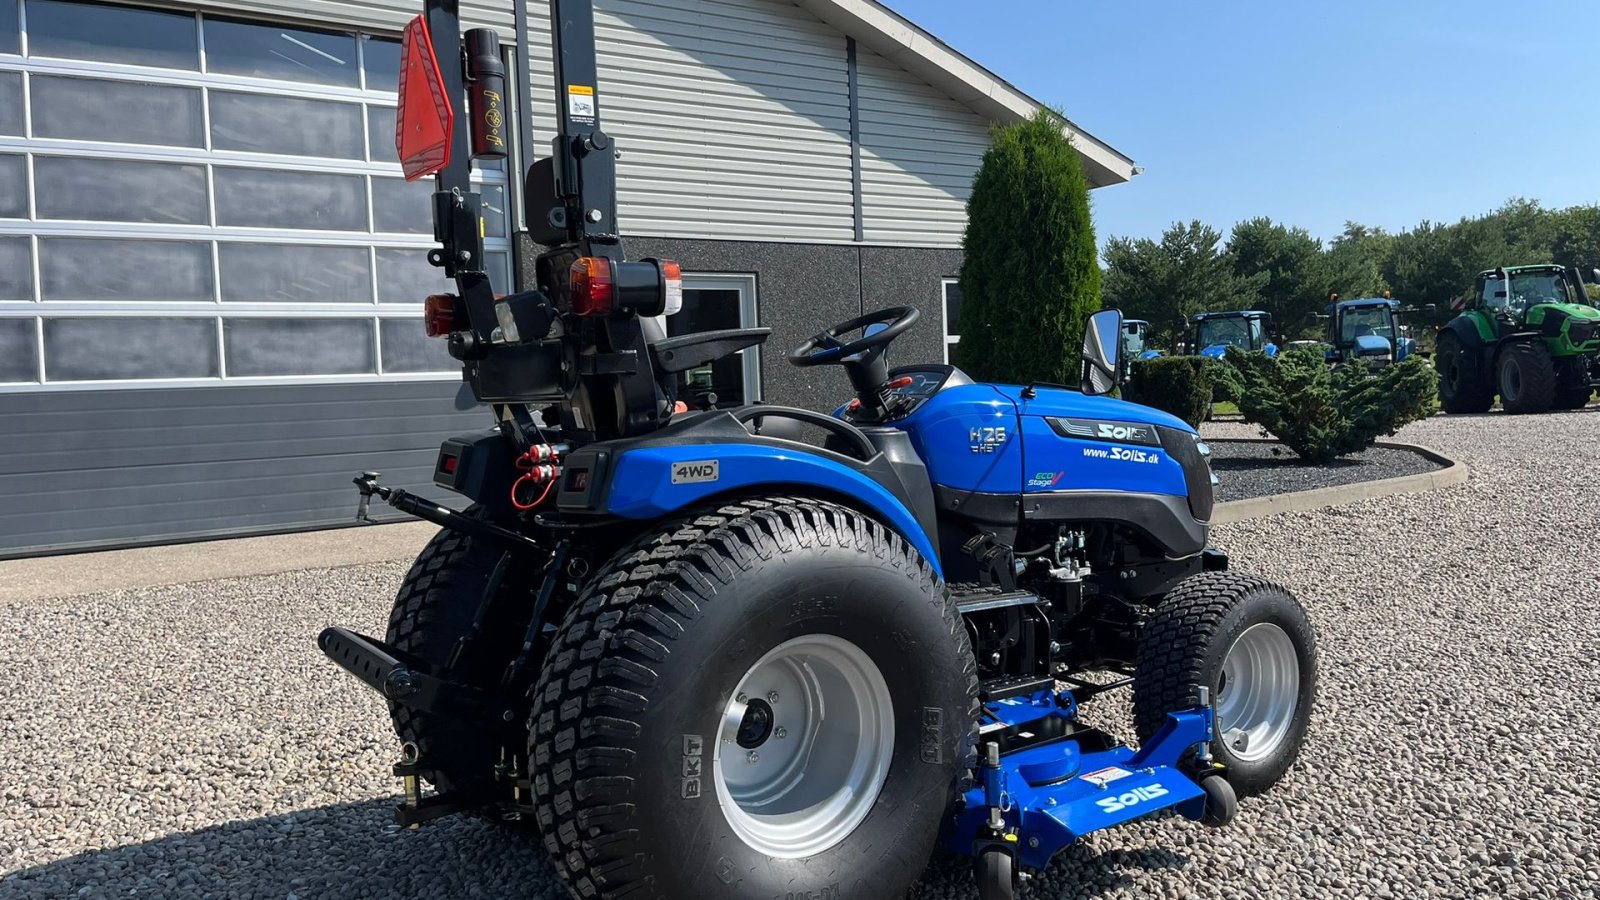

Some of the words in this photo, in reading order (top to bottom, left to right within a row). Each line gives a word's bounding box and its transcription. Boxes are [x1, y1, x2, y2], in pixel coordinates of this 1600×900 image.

[676, 464, 714, 478] 4WD
[1035, 472, 1054, 480] ECO
[1027, 479, 1052, 488] Stage
[683, 736, 702, 797] BKT
[1094, 783, 1169, 814] Solis
